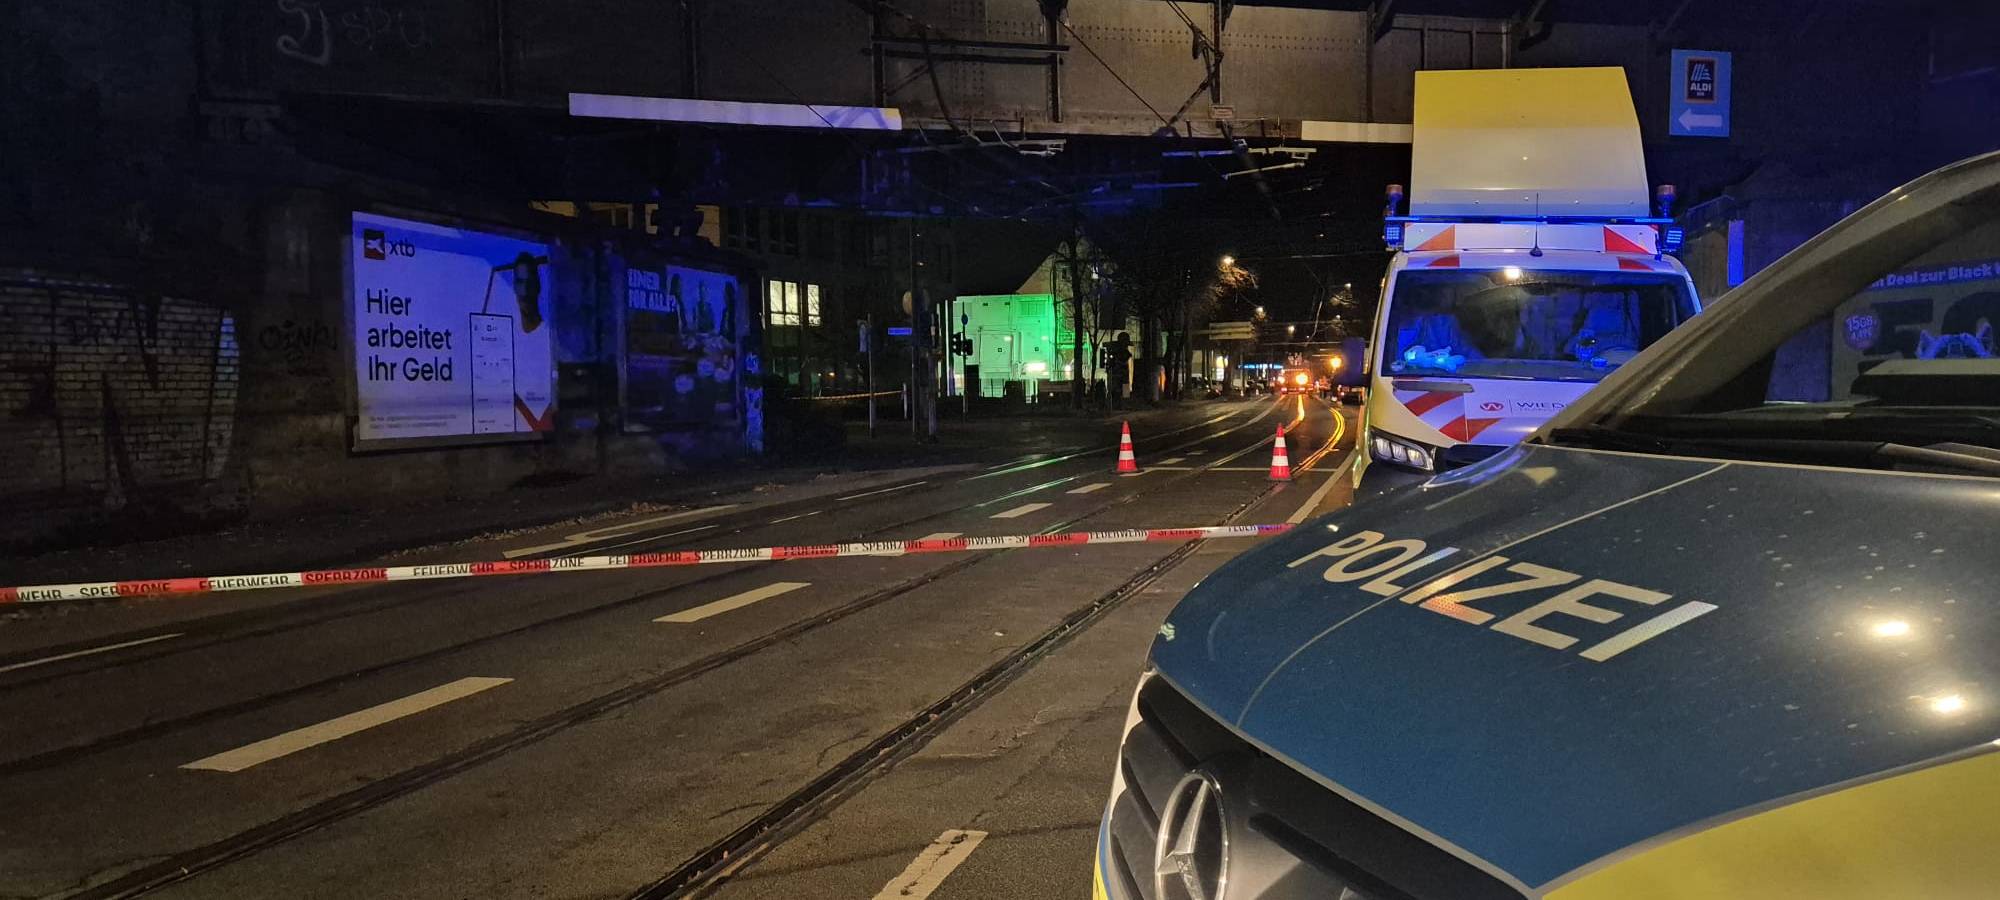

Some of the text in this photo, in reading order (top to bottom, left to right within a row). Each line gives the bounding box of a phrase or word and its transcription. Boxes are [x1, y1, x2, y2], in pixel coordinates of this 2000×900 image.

[1690, 82, 1712, 92] ALDI
[389, 238, 415, 257] xtb
[1886, 271, 1918, 287] Deal
[1919, 270, 1946, 284] zur
[1948, 263, 1993, 280] Black
[367, 288, 411, 316] Hier
[367, 322, 452, 350] arbeitet
[368, 354, 453, 382] Ihr Geld
[199, 575, 289, 591] FEUERWEHR
[305, 568, 388, 585] SPERRZONE
[412, 562, 495, 576] FEUERWEHR
[510, 557, 585, 572] SPERRZONE
[608, 551, 682, 565] FEUERWEHR
[694, 547, 762, 561] SPERRZONE
[862, 540, 923, 553] SPERRZONE
[1287, 530, 1719, 662] POLIZEI
